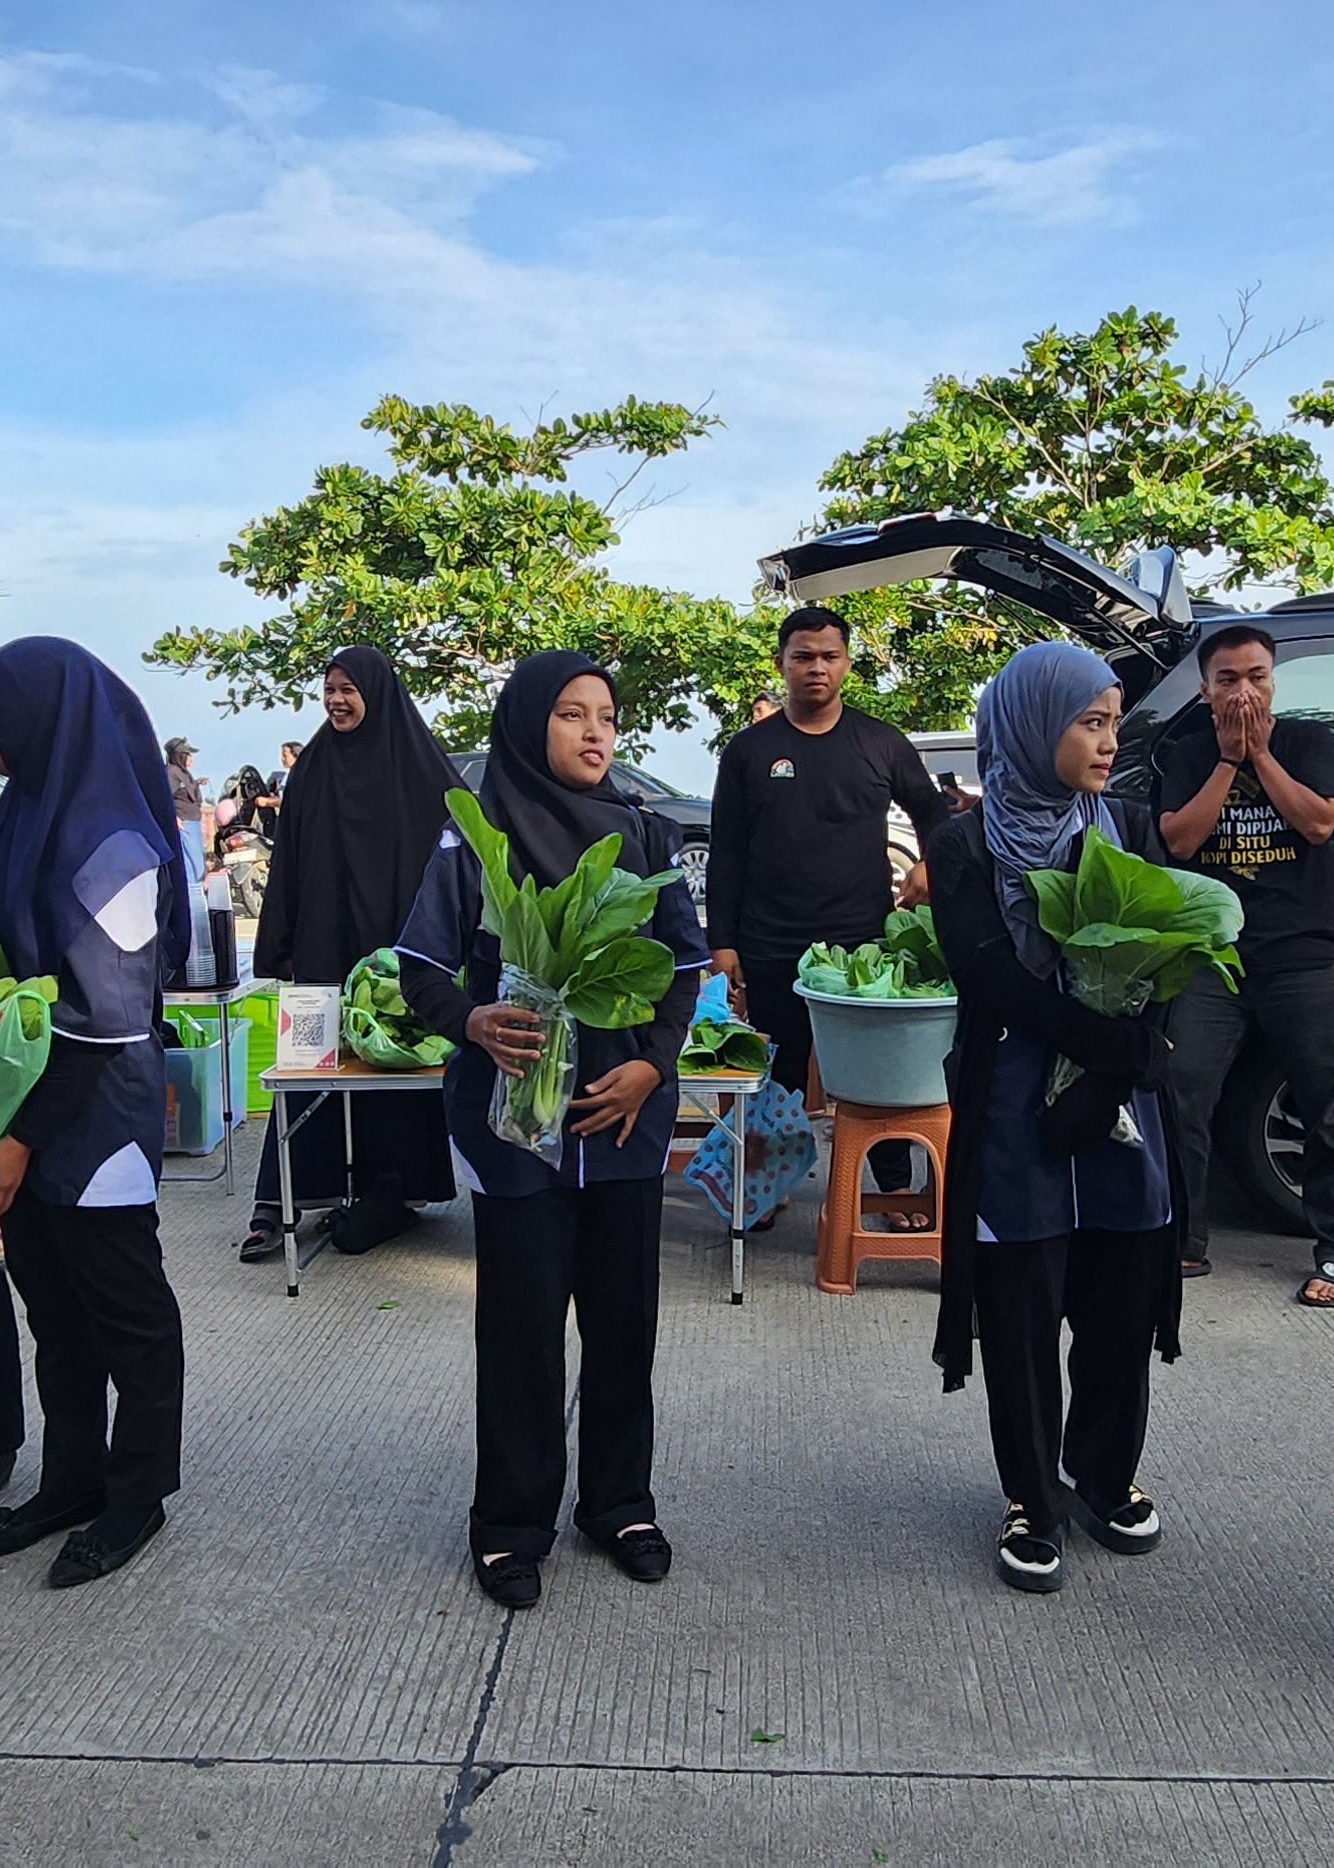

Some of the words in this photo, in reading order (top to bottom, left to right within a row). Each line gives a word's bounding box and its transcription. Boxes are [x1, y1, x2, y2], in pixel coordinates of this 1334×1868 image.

[1221, 807, 1226, 820] I
[1229, 805, 1276, 821] MANA
[1219, 836, 1232, 850] DI
[1236, 835, 1271, 850] SITU
[1230, 846, 1297, 865] DISEDUH
